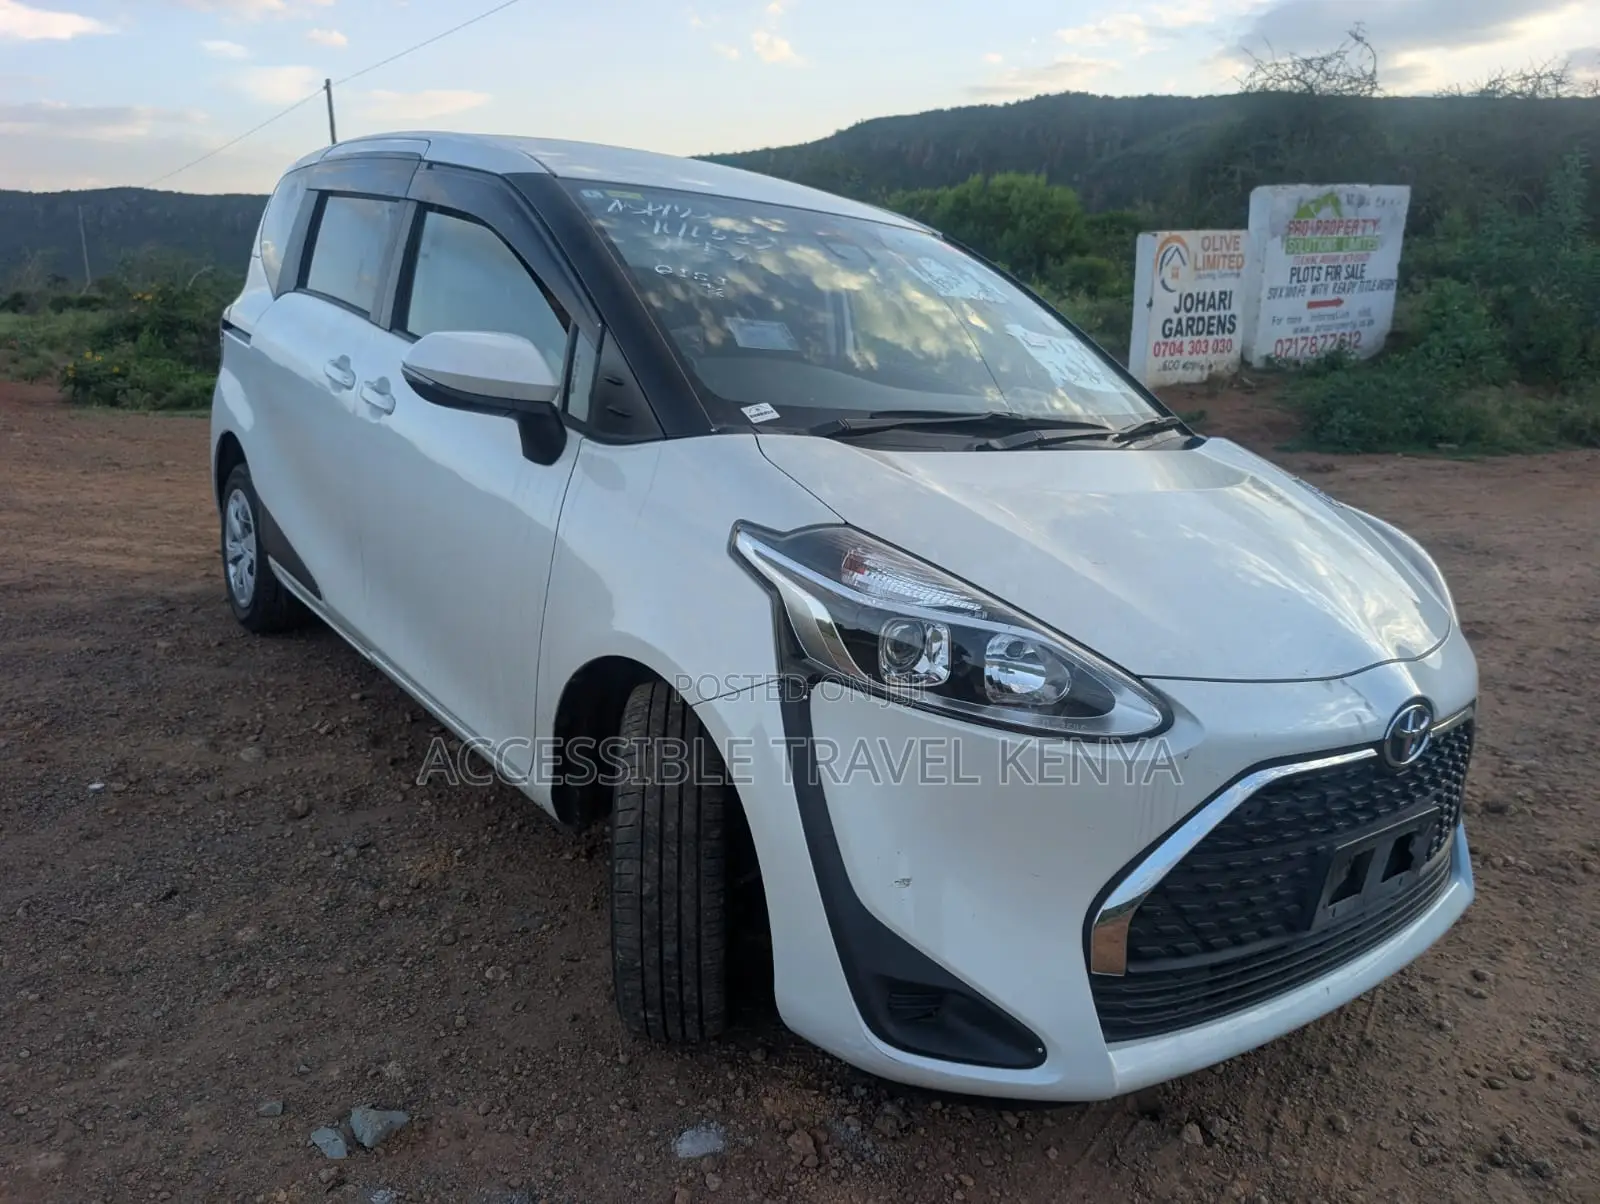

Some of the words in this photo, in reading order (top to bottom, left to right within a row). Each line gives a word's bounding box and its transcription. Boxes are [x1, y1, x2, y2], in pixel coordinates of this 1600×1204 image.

[1201, 235, 1241, 253] OLIVE
[1194, 253, 1245, 272] LIMITED
[1289, 265, 1323, 284] PLOTS
[1324, 264, 1343, 282] FOR
[1344, 263, 1367, 280] SALE
[1173, 290, 1233, 314] JOHARI
[1161, 314, 1237, 339] GARDENS
[1153, 340, 1185, 357] 0704
[1187, 340, 1210, 356] 303
[1211, 338, 1233, 354] 030
